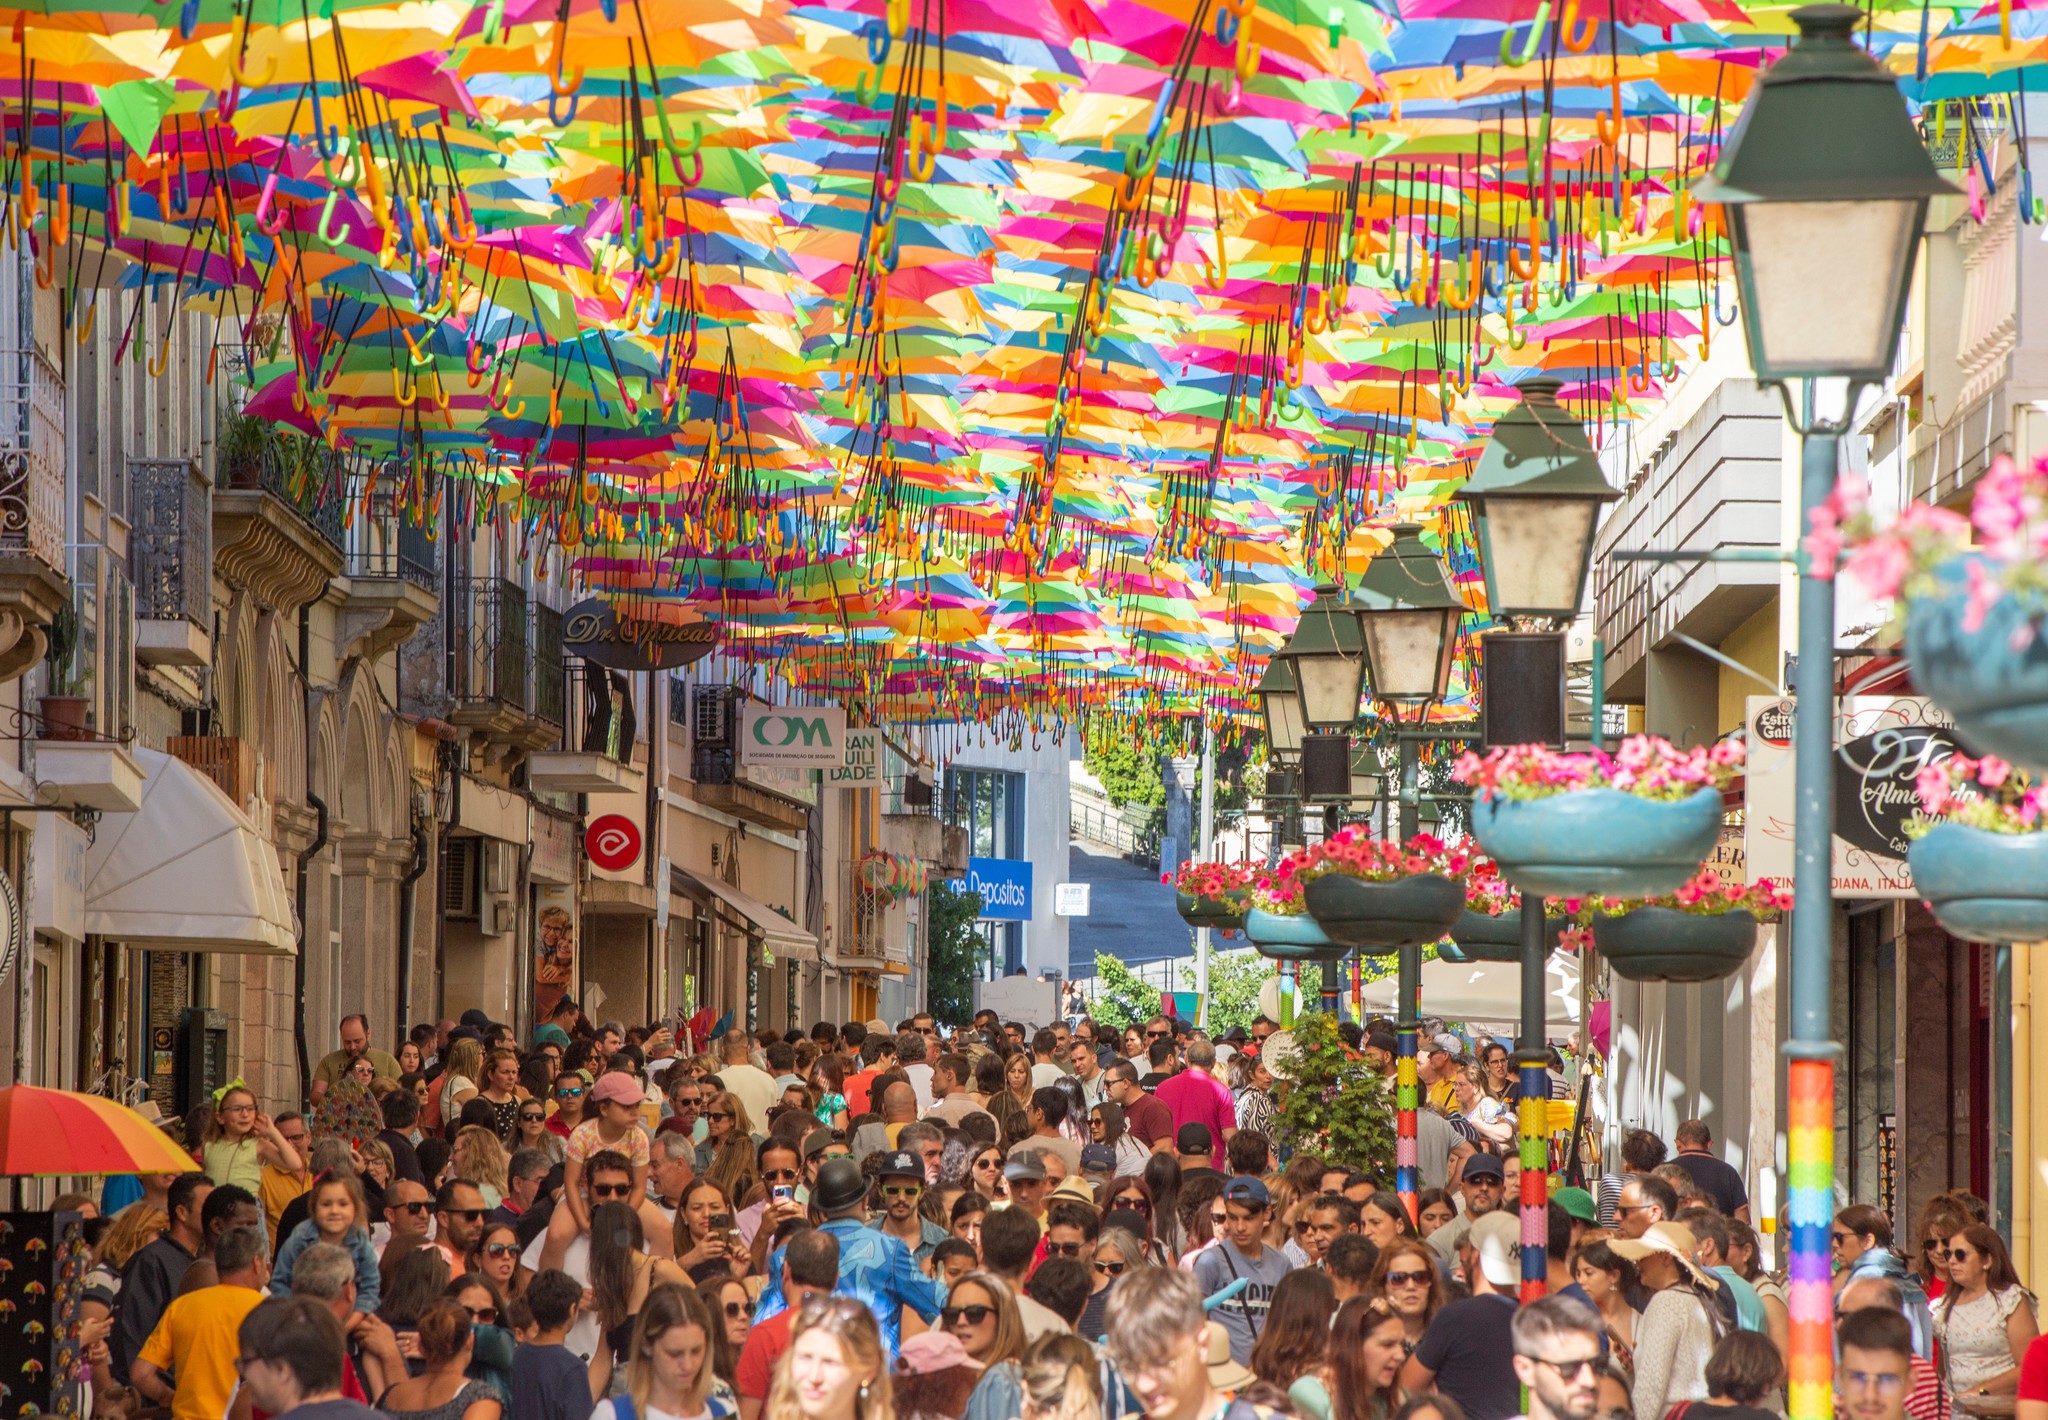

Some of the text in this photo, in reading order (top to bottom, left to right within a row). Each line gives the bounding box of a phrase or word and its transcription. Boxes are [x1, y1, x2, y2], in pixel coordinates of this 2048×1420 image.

[564, 613, 615, 643] Dr.
[1763, 725, 1792, 739] Gali
[845, 751, 875, 765] UILI
[830, 766, 876, 781] DADE
